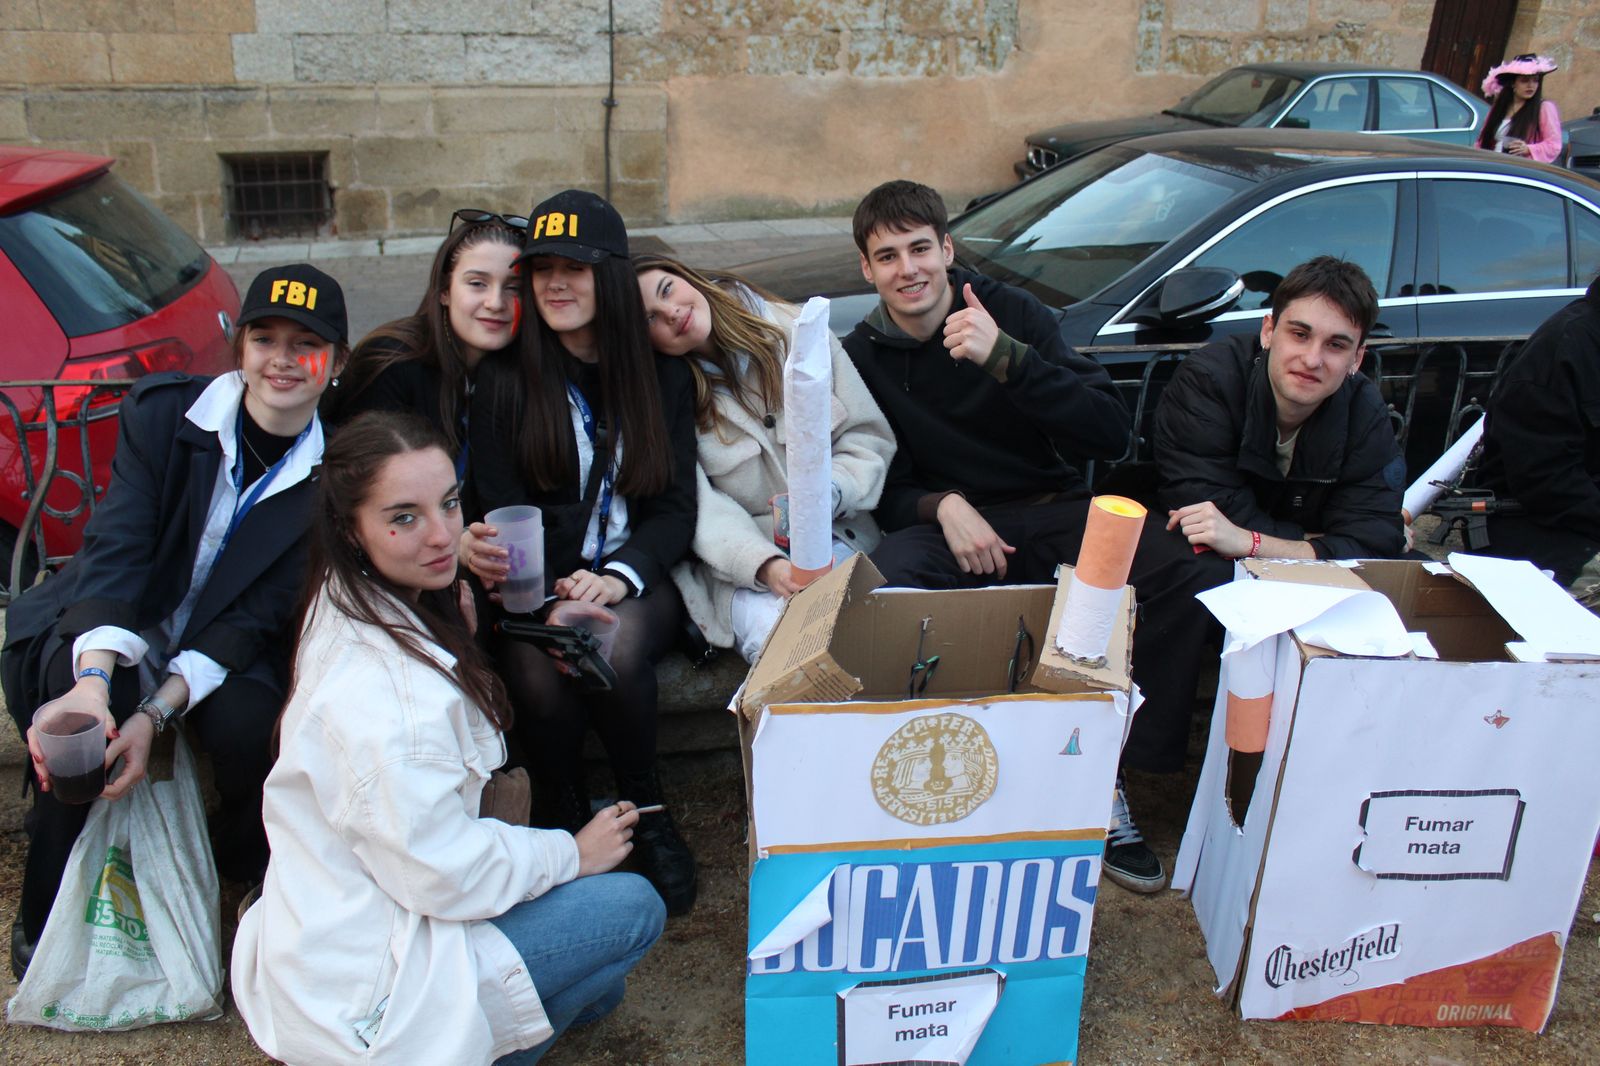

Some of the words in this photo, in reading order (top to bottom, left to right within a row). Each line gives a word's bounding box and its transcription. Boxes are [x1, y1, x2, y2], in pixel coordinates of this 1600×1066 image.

[532, 212, 578, 240] FBI
[270, 279, 318, 311] FBI
[1405, 815, 1474, 832] Fumar
[1407, 840, 1461, 855] mata
[751, 854, 1101, 975] UCADOS
[1264, 923, 1400, 989] Chesterfield
[887, 1000, 957, 1021] Fumar
[1437, 1002, 1513, 1021] ORIGINAL
[894, 1022, 949, 1042] mata
